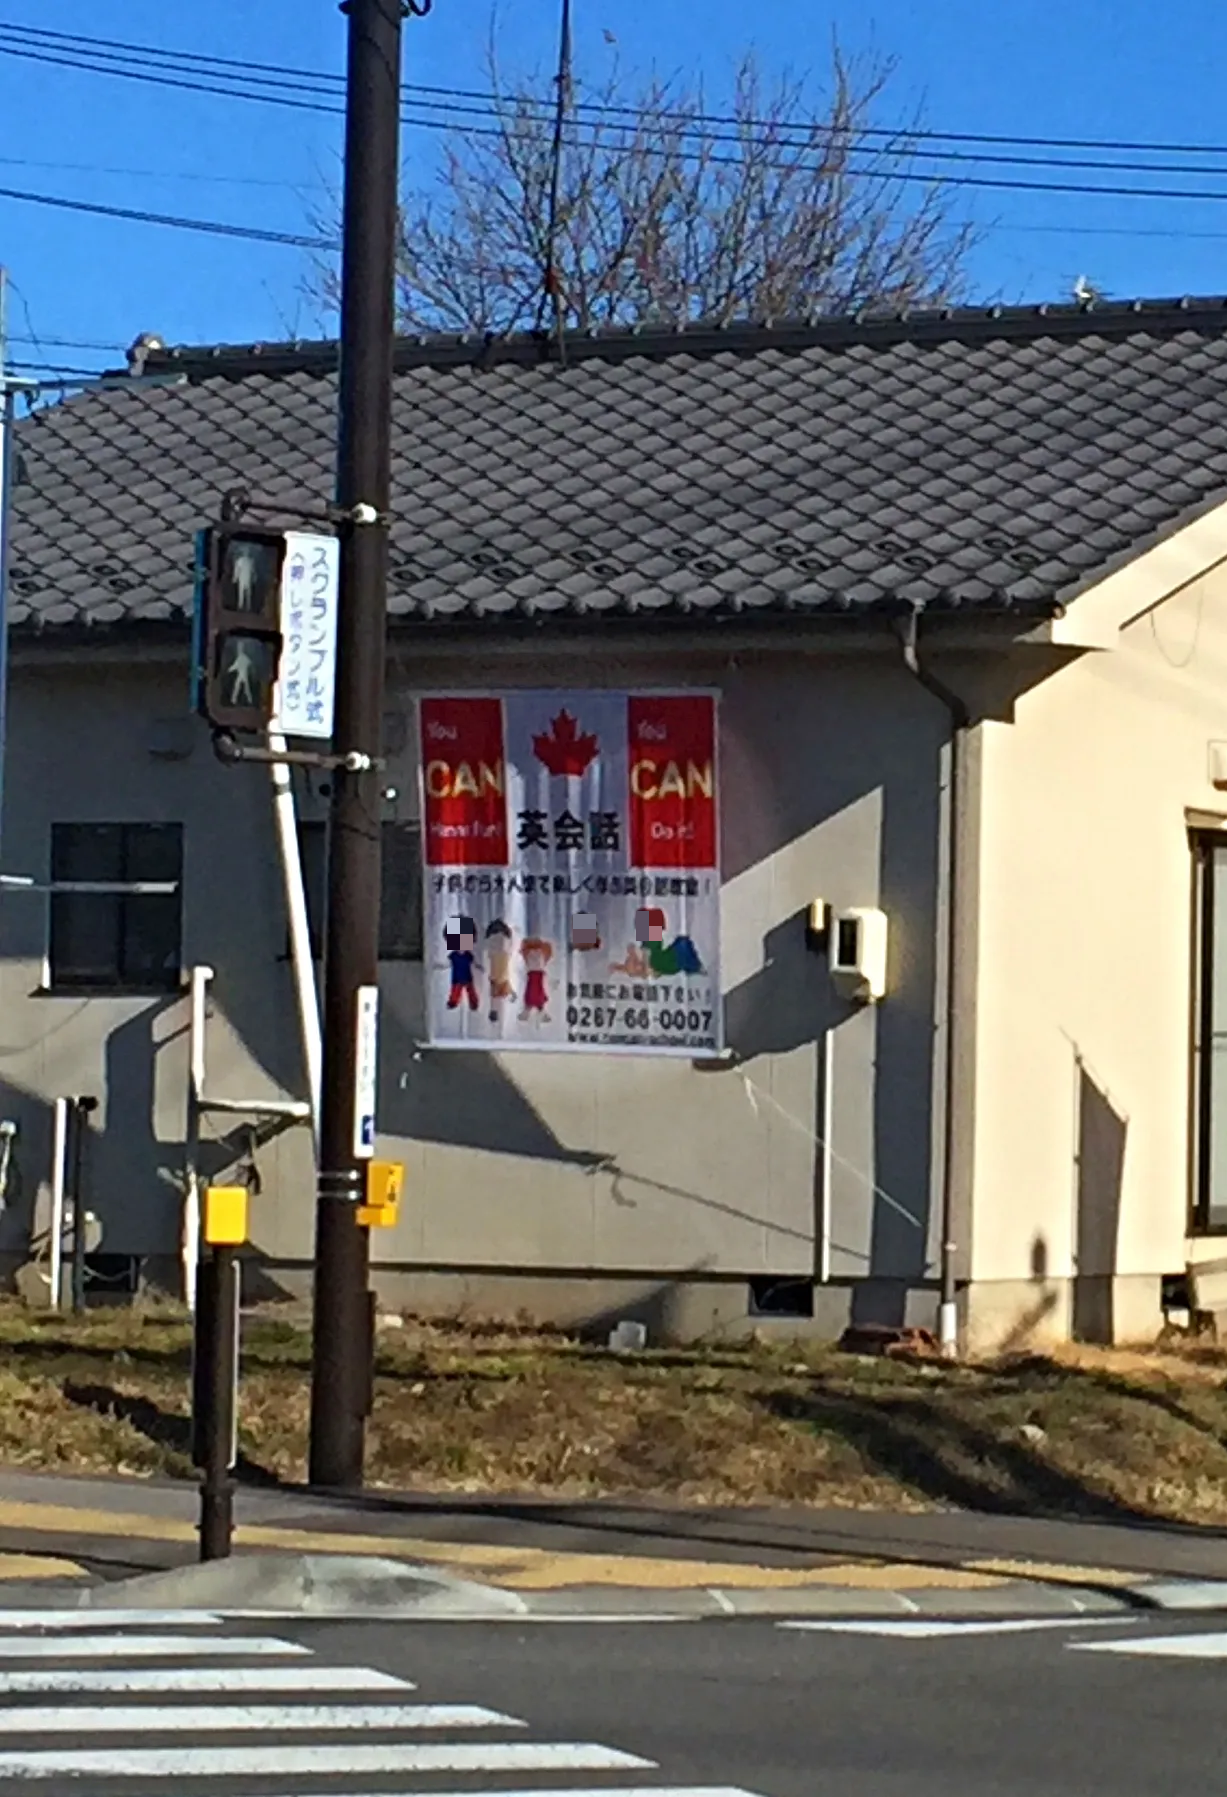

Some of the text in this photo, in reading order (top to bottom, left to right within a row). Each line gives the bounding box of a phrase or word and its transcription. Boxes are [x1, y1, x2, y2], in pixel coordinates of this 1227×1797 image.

[427, 759, 505, 798] CAN
[631, 759, 713, 800] CAN
[516, 809, 621, 851] 英会話
